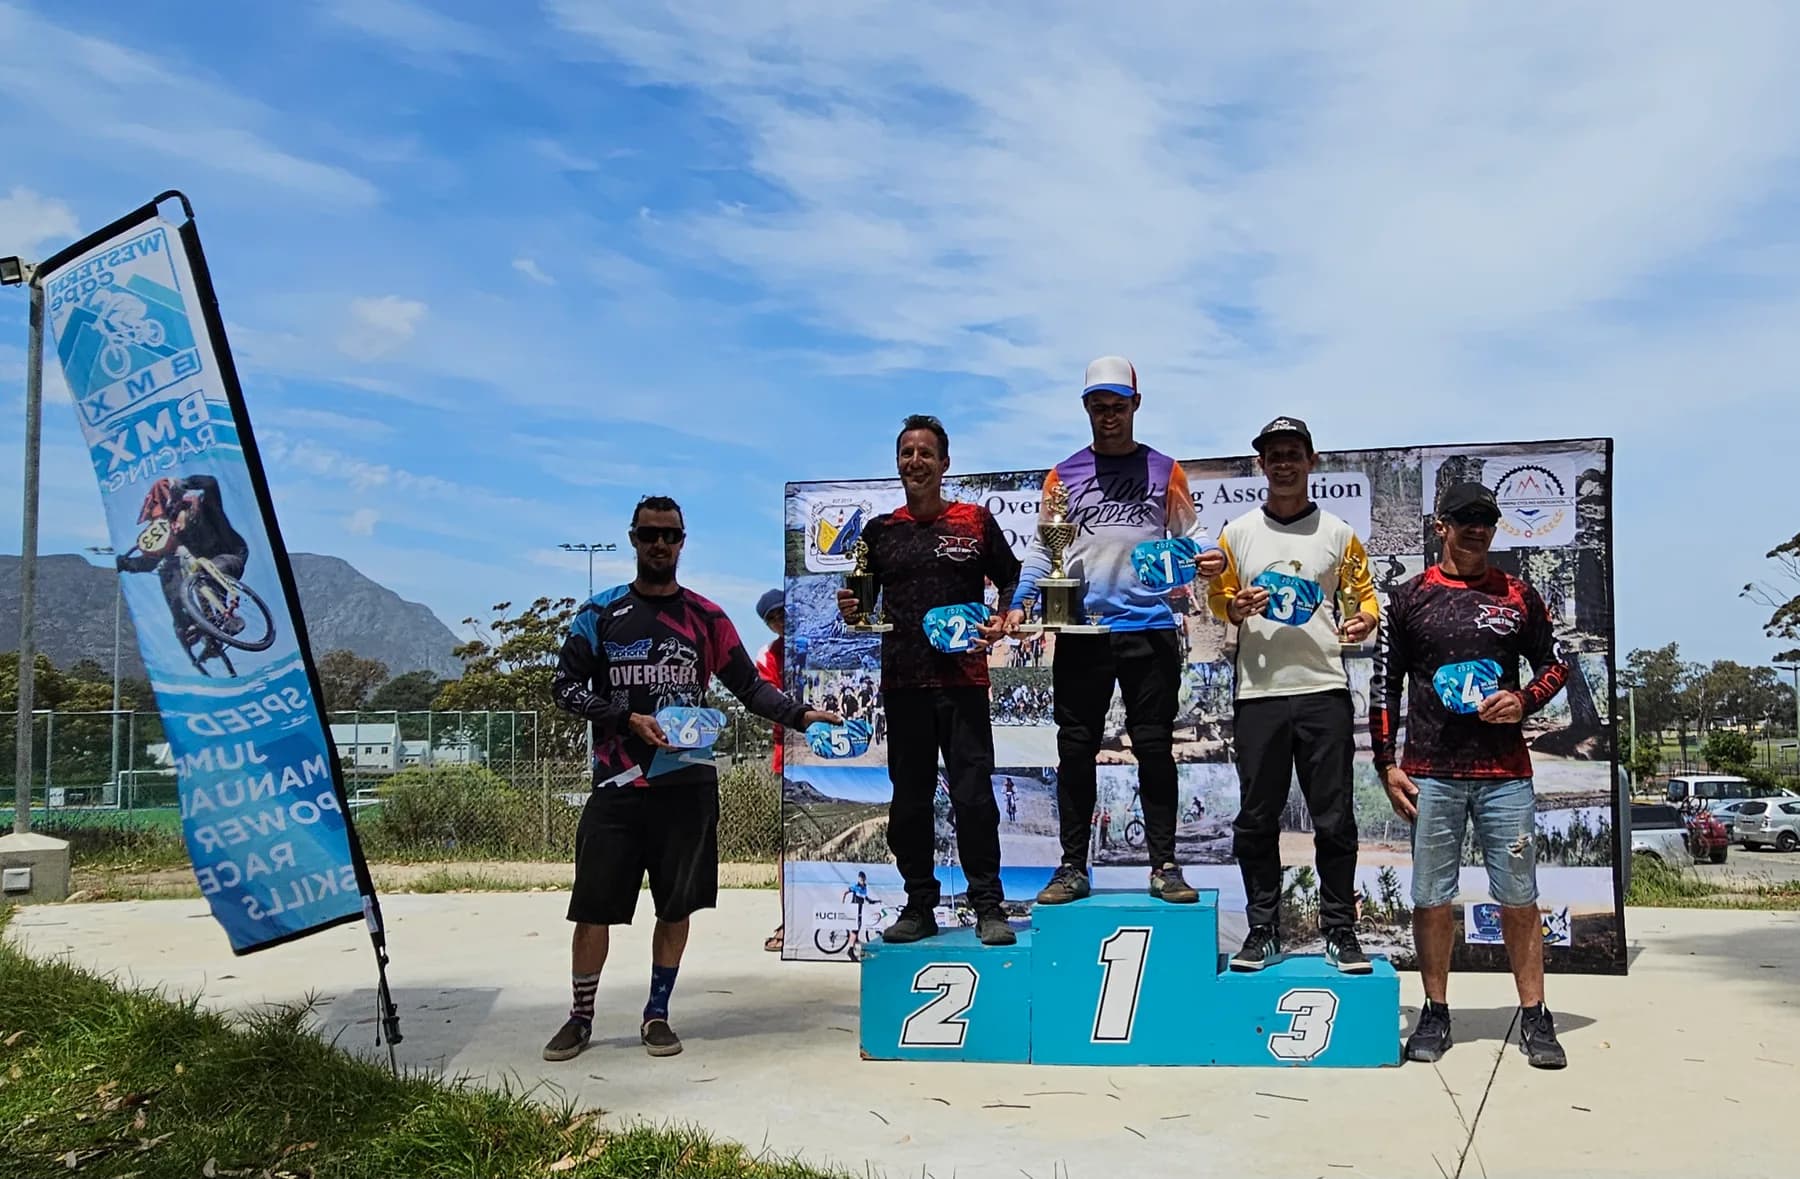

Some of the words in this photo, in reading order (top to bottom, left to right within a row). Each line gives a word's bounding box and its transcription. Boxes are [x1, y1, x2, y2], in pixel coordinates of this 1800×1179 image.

[985, 496, 1041, 515] Over
[1213, 478, 1362, 504] Assotion
[1077, 503, 1152, 537] RIDERS
[1160, 550, 1174, 584] 1
[1273, 586, 1296, 620] 3
[947, 615, 968, 648] 2
[1461, 672, 1484, 706] 4
[679, 716, 698, 745] 6
[831, 729, 850, 756] 5
[1090, 926, 1153, 1044] 1
[899, 962, 980, 1048] 2
[1267, 988, 1340, 1061] 3
